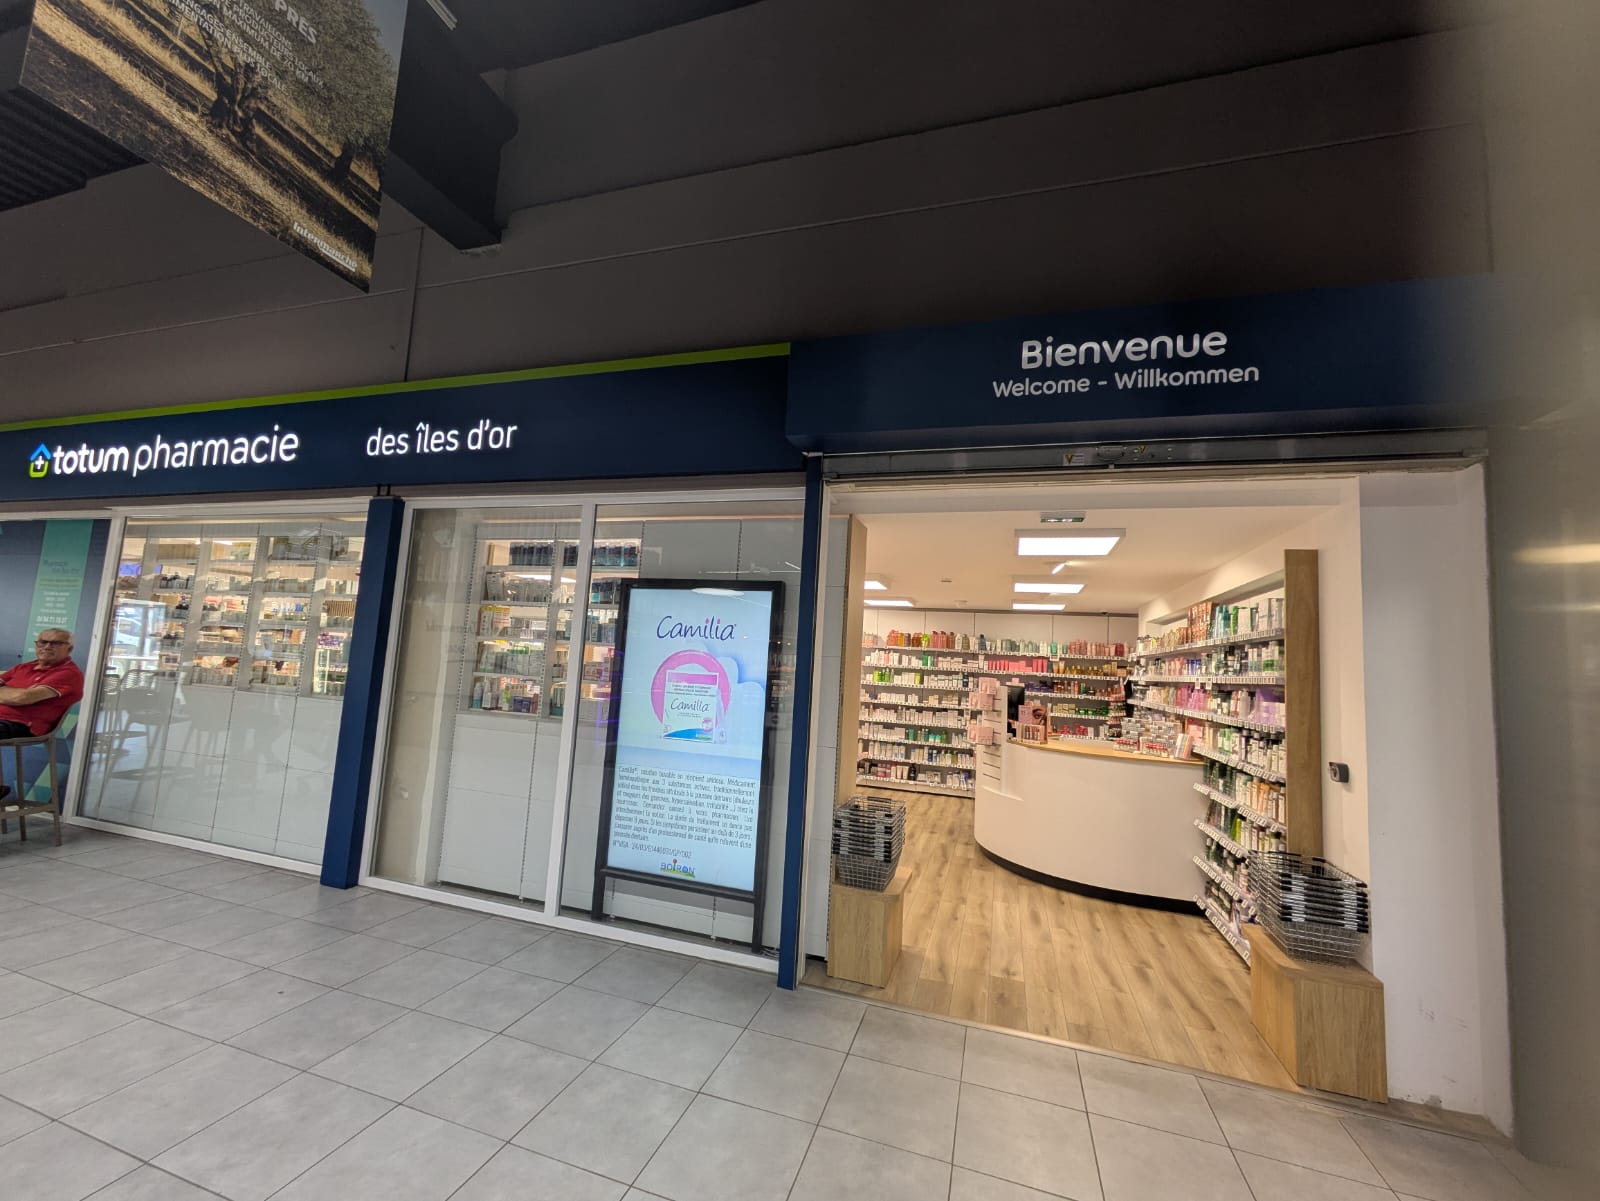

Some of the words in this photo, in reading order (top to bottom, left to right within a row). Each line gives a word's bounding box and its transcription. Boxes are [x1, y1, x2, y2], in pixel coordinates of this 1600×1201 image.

[222, 6, 269, 49] MAXIMUM
[270, 46, 283, 61] DE
[296, 67, 309, 83] KM
[226, 30, 273, 71] ENSEMBLE
[233, 4, 293, 61] PRODUCTEURS
[295, 56, 323, 88] LOCAUX
[232, 44, 255, 68] PLUS
[256, 62, 286, 92] LOCALE
[1022, 332, 1228, 370] Bienvenue
[992, 377, 1091, 398] Welcome
[1115, 365, 1260, 390] Willkommen
[53, 443, 130, 475] totum
[132, 424, 299, 478] pharmacie
[366, 426, 409, 457] des
[416, 421, 460, 454] îles
[467, 419, 519, 451] d'or
[670, 697, 711, 713] Camilia
[660, 858, 695, 875] BOIRON
